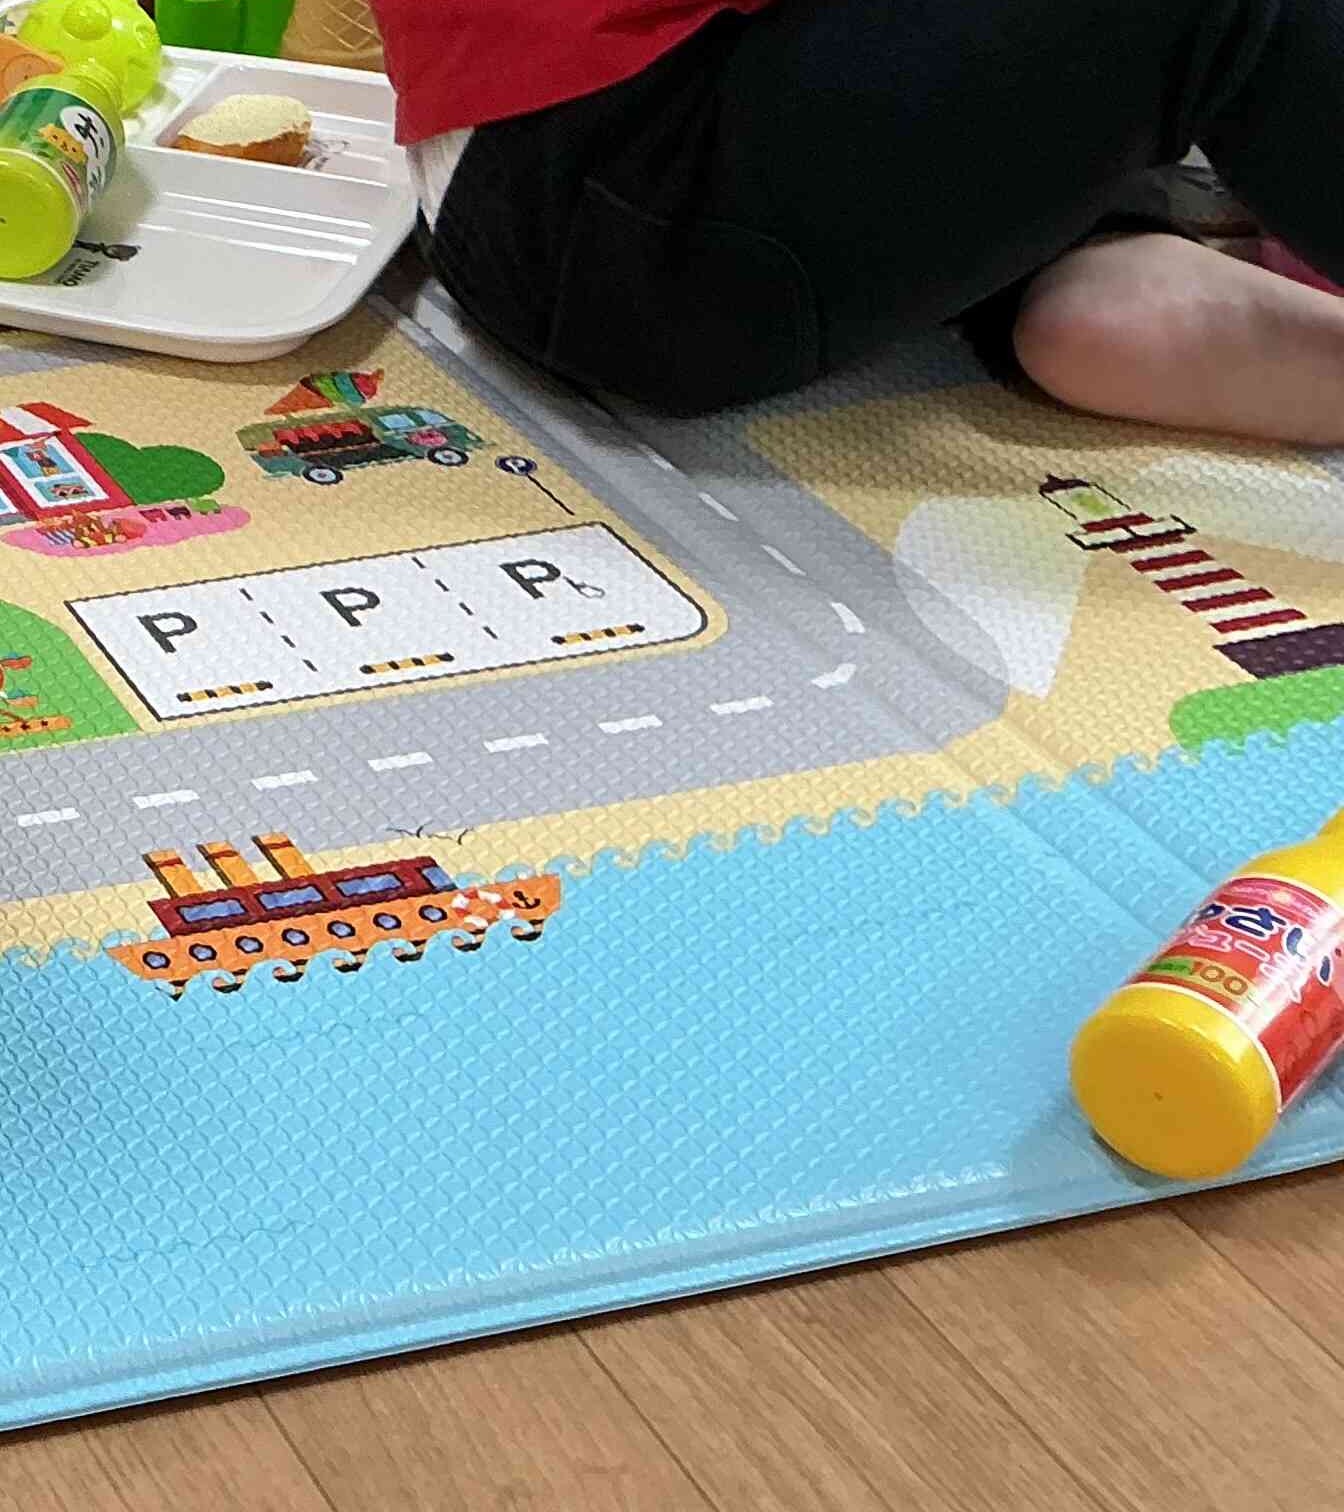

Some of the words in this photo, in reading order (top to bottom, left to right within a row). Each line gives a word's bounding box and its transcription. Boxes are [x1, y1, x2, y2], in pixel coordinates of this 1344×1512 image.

[500, 559, 561, 599] P
[320, 587, 381, 627] P
[137, 612, 198, 653] P
